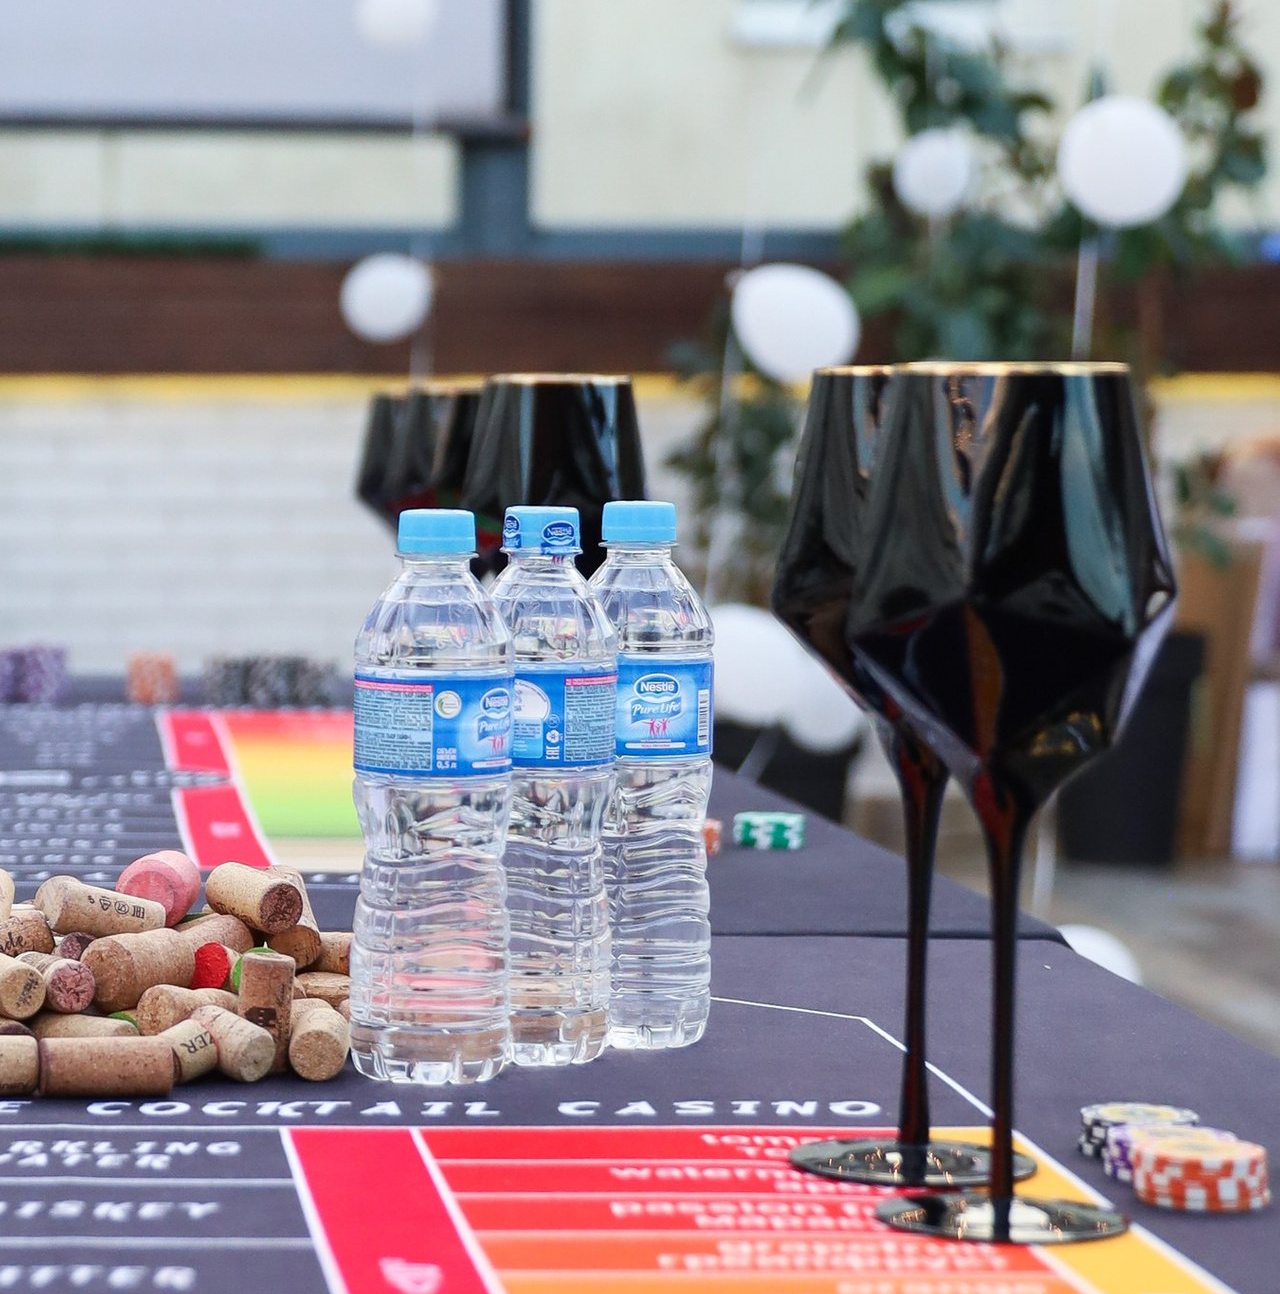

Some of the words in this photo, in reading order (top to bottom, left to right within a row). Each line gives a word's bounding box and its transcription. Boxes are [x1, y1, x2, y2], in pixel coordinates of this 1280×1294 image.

[640, 681, 675, 692] Nestlé
[86, 1100, 501, 1117] COCKTAIL
[557, 1100, 882, 1117] CASINO
